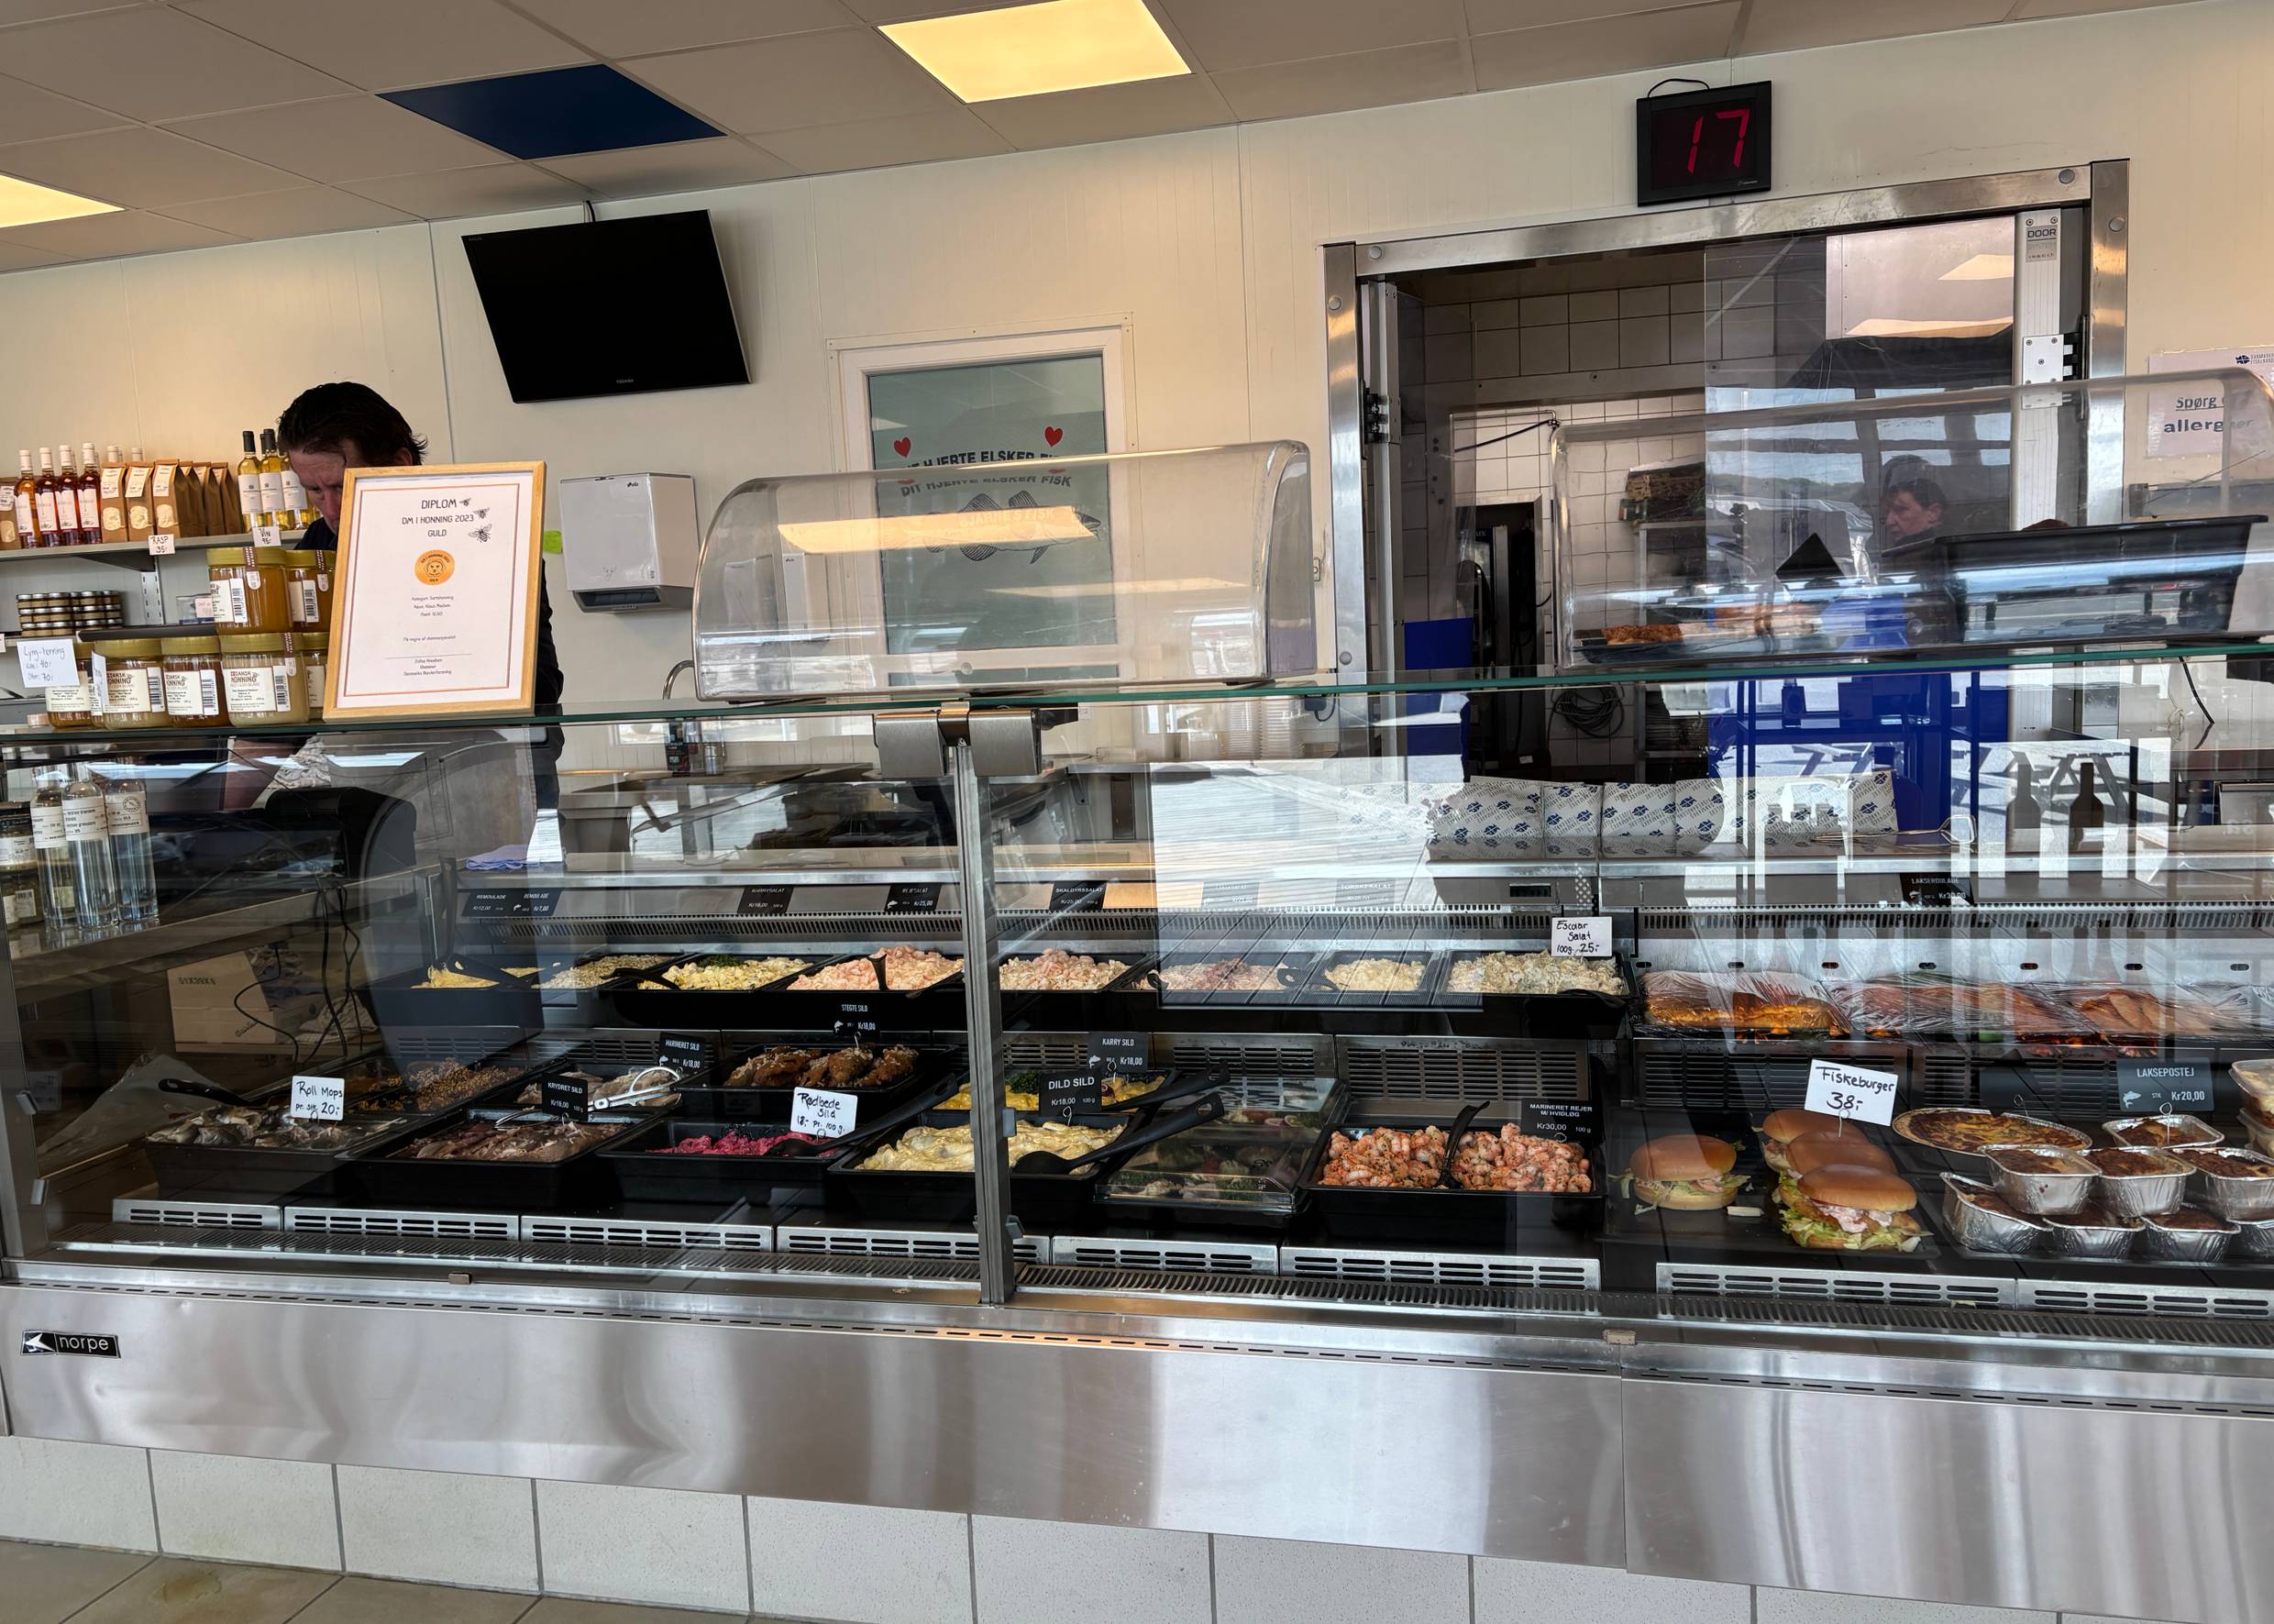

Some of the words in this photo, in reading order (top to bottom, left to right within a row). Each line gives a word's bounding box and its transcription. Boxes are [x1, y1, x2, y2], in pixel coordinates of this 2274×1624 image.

[1686, 108, 1750, 174] 17
[2027, 228, 2057, 238] DOOR
[2176, 396, 2217, 409] Spørg
[421, 499, 458, 510] DIPLOM
[402, 516, 414, 525] DM
[420, 515, 453, 524] HONNING
[455, 514, 474, 523] 2023
[427, 528, 447, 537] GULD
[1567, 931, 1592, 942] Salat
[841, 1004, 857, 1012] STEGTE
[857, 1004, 868, 1012] SILD
[665, 1039, 690, 1049] MARINERET
[690, 1043, 701, 1052] SILD
[1102, 1038, 1120, 1046] KARRY
[1121, 1039, 1134, 1047] SILD
[682, 1058, 701, 1068] Kr18,00
[1120, 1056, 1143, 1066] Kr18,00
[2136, 1067, 2194, 1077] LAKSEPOSTEJ
[1048, 1079, 1071, 1090] DILD
[1073, 1077, 1095, 1088] SILD
[1815, 1066, 1895, 1095] Fiskeburger
[296, 1081, 316, 1097] Roll
[321, 1087, 343, 1100] Mops
[547, 1081, 570, 1092] KRYDRET
[570, 1085, 583, 1094] SILD
[1051, 1097, 1076, 1107] Kr18,00
[2171, 1091, 2205, 1102] Kr20,00
[817, 1108, 836, 1119] Sild
[825, 1122, 836, 1131] 100
[1537, 1122, 1567, 1131] Kr30,00
[59, 1336, 109, 1353] norpe
